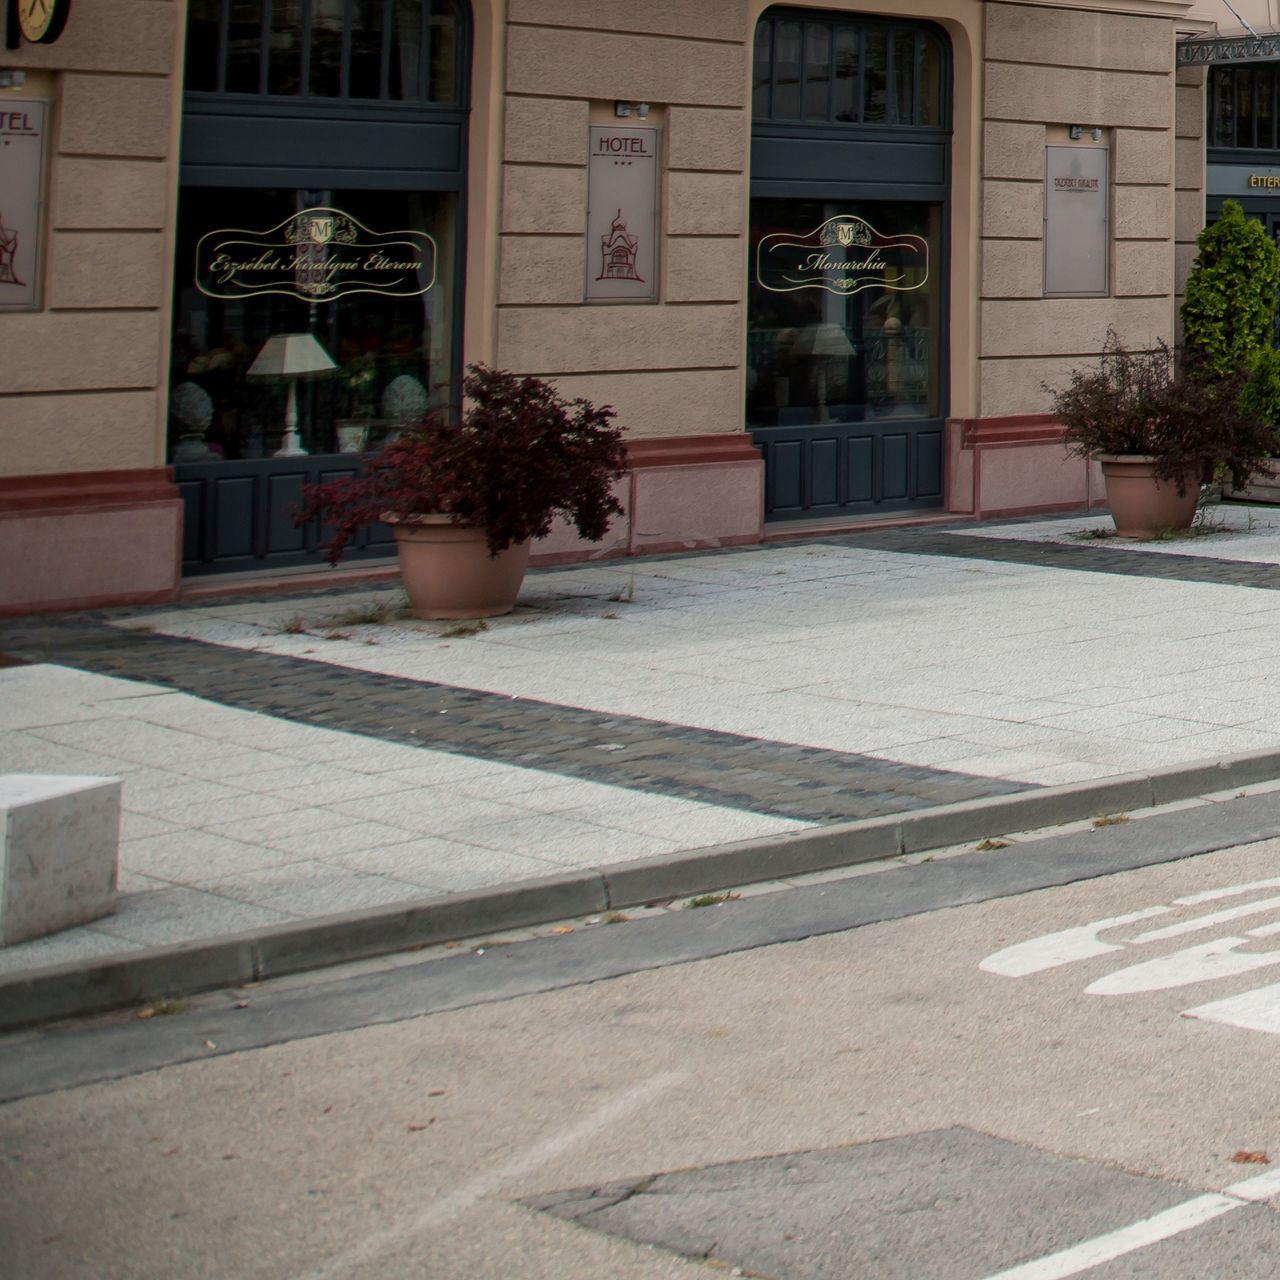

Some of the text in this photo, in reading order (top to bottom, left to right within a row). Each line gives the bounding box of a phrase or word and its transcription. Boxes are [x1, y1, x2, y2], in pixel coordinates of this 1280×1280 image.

[0, 112, 34, 130] TEL
[600, 137, 647, 153] HOTEL
[313, 221, 330, 237] M
[840, 227, 853, 241] M
[209, 249, 423, 284] Erzsébet Királyné Étterem
[798, 249, 887, 271] Monarchia
